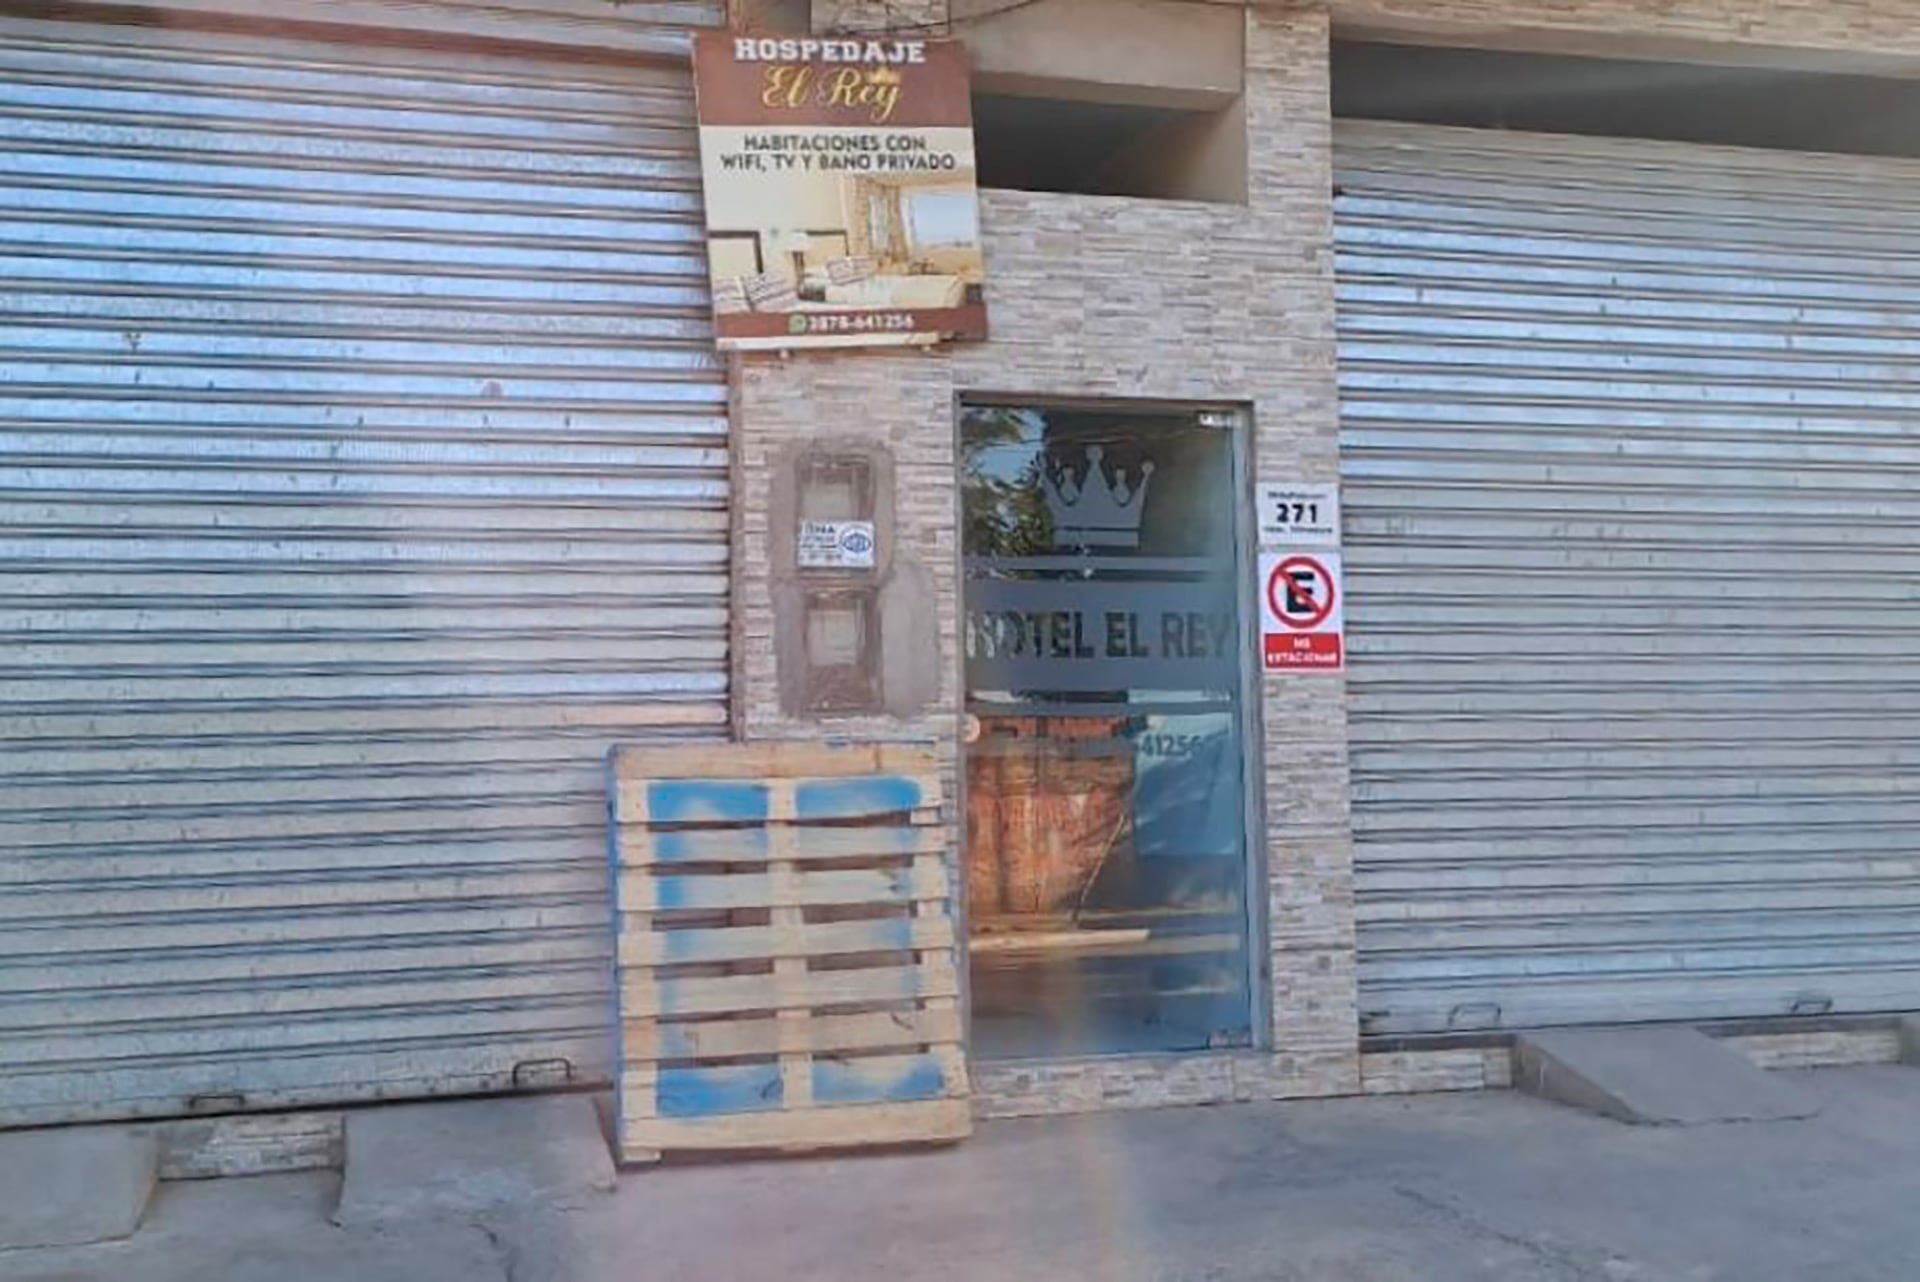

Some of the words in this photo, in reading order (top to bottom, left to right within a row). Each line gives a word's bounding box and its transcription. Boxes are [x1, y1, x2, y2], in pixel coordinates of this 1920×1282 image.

[734, 38, 926, 63] HOSPEDAJE
[762, 65, 814, 108] El
[830, 67, 901, 123] Rey
[744, 134, 880, 151] HABITACIONES
[886, 136, 925, 151] CON
[775, 154, 797, 170] TV
[800, 154, 812, 170] Y
[876, 153, 956, 170] PRIVADO
[1276, 503, 1317, 523] 271
[1105, 611, 1149, 658] EL
[1161, 612, 1232, 659] REY
